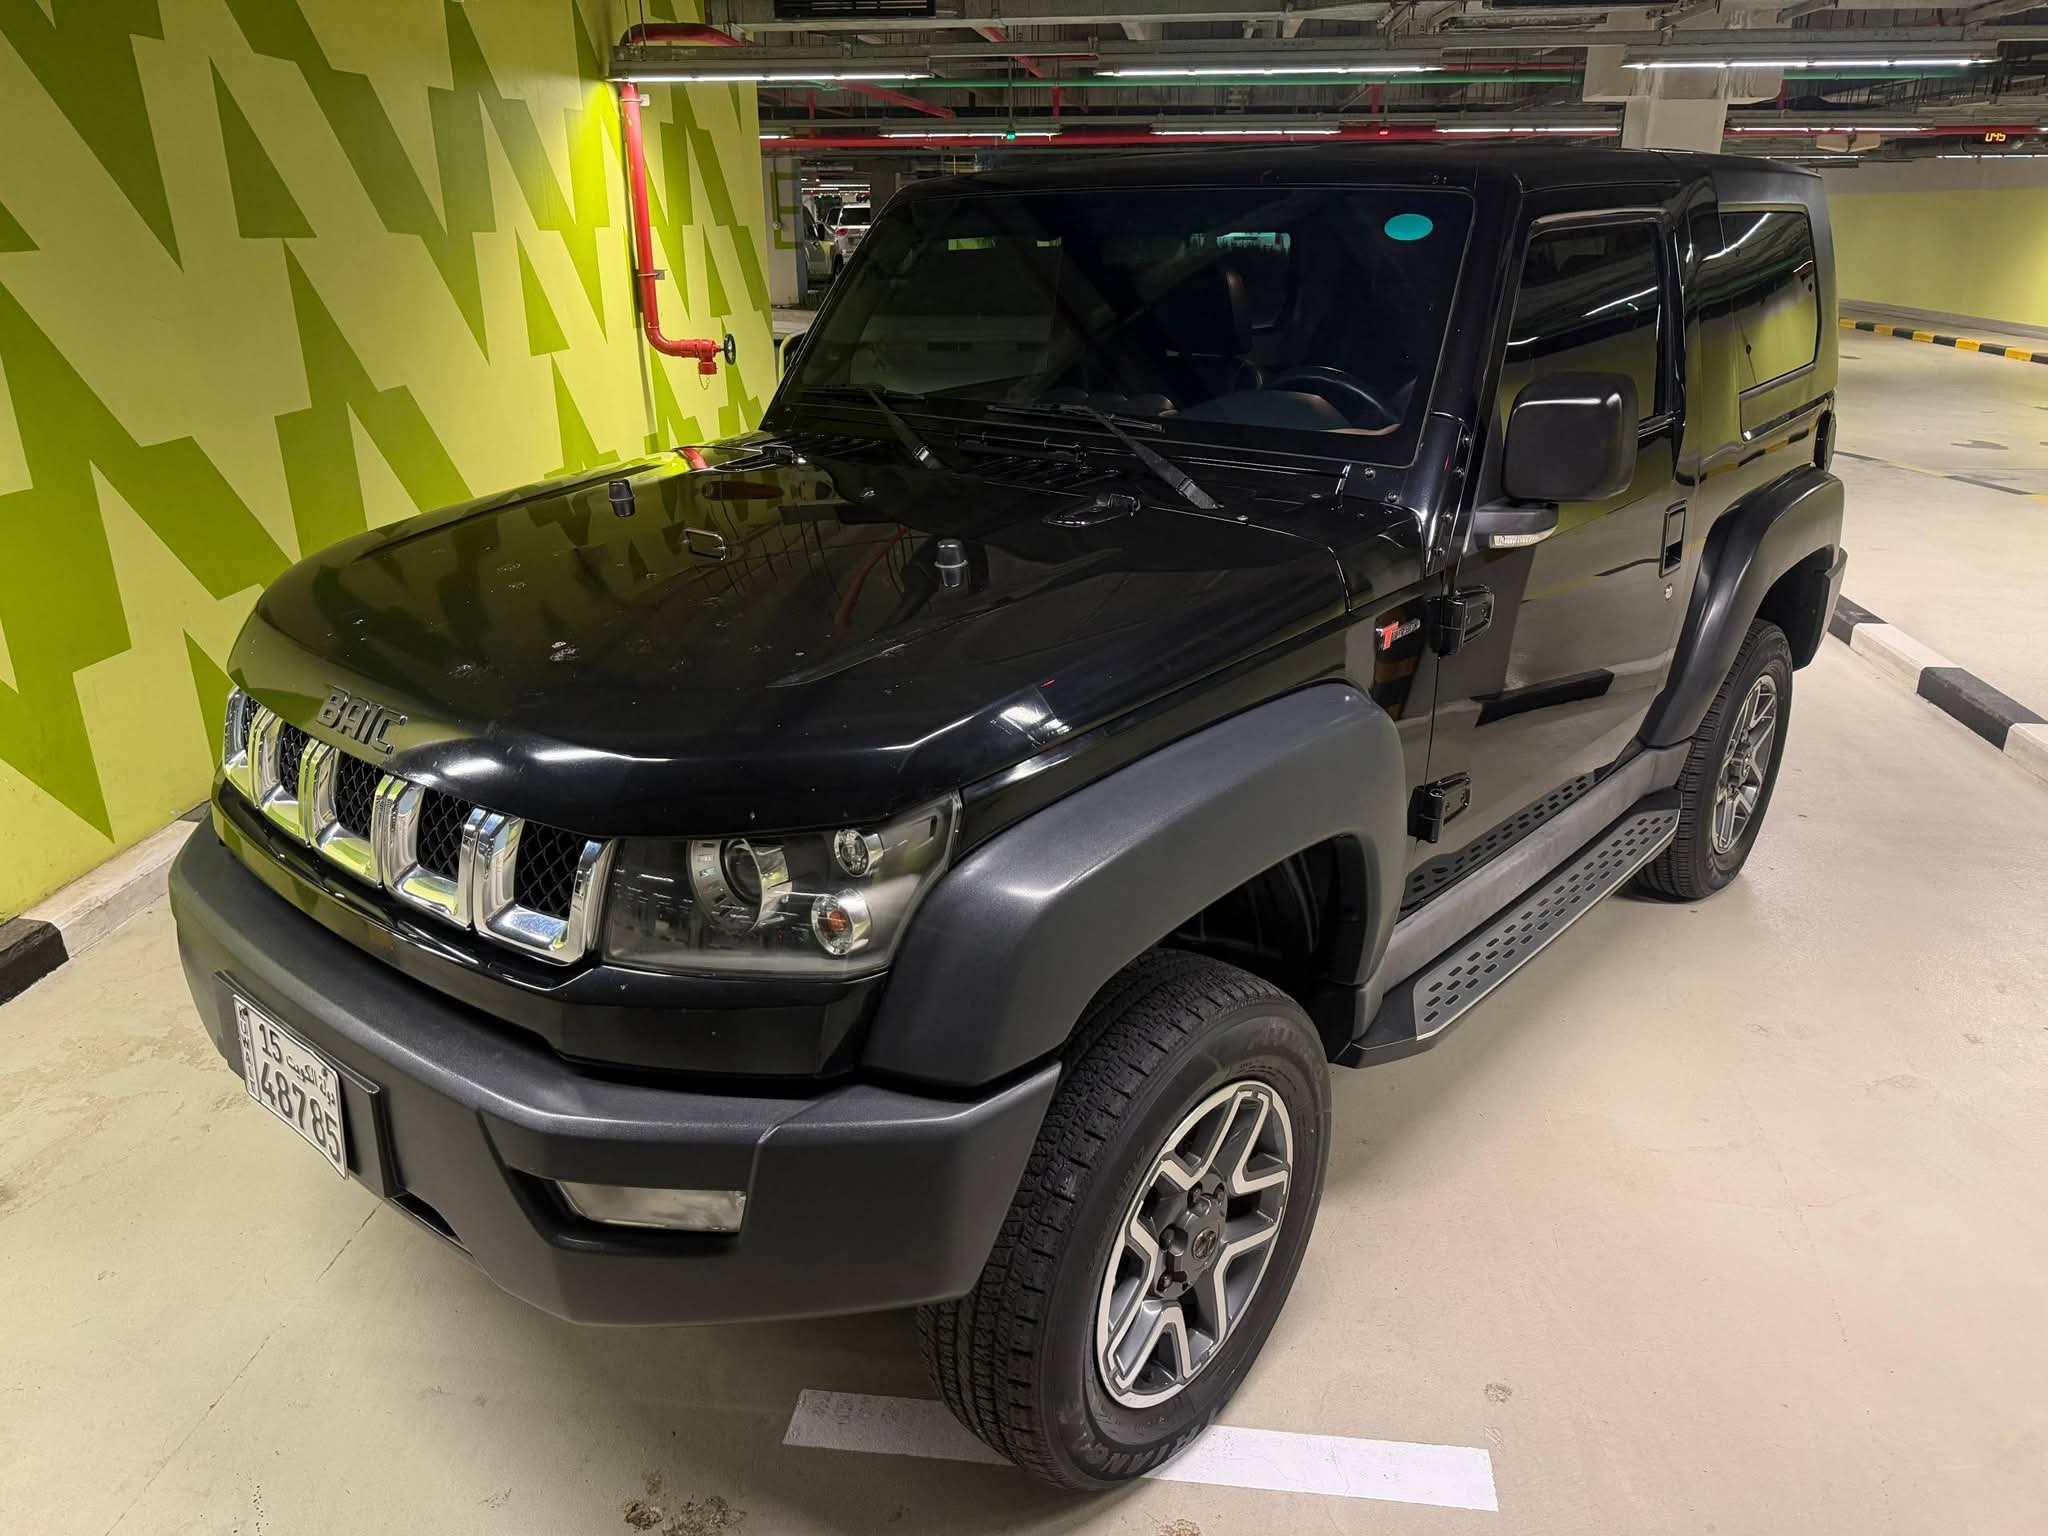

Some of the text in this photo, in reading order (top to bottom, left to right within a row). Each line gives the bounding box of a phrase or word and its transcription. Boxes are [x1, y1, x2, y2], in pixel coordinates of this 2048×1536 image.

[316, 685, 408, 756] BAIC
[259, 1023, 283, 1065] 15
[260, 1061, 341, 1163] 48785
